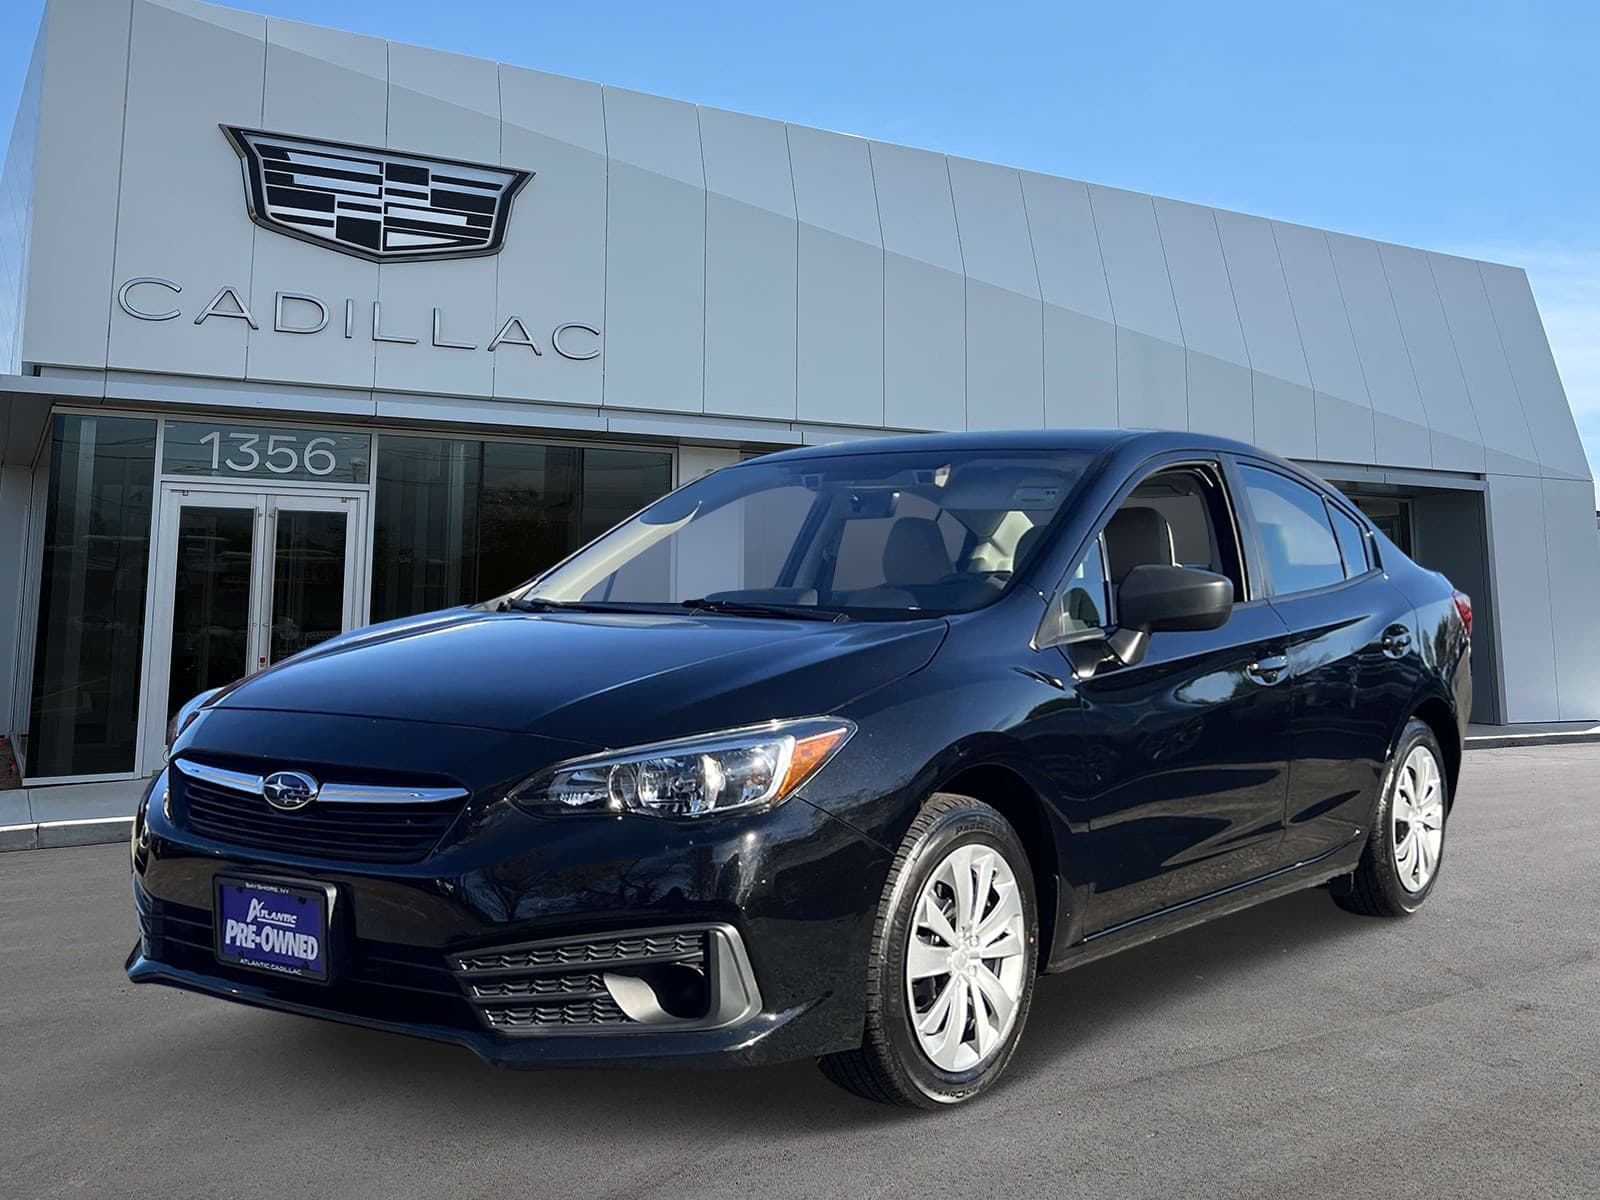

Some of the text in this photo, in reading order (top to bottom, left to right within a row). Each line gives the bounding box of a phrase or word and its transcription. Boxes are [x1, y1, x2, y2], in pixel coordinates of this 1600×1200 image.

[118, 277, 602, 360] CADILLAC
[200, 430, 337, 477] 1356
[246, 897, 297, 924] ATLANTIC
[225, 918, 319, 961] PRE-OWNED
[240, 958, 302, 976] ATLANTIC CADILLAC
